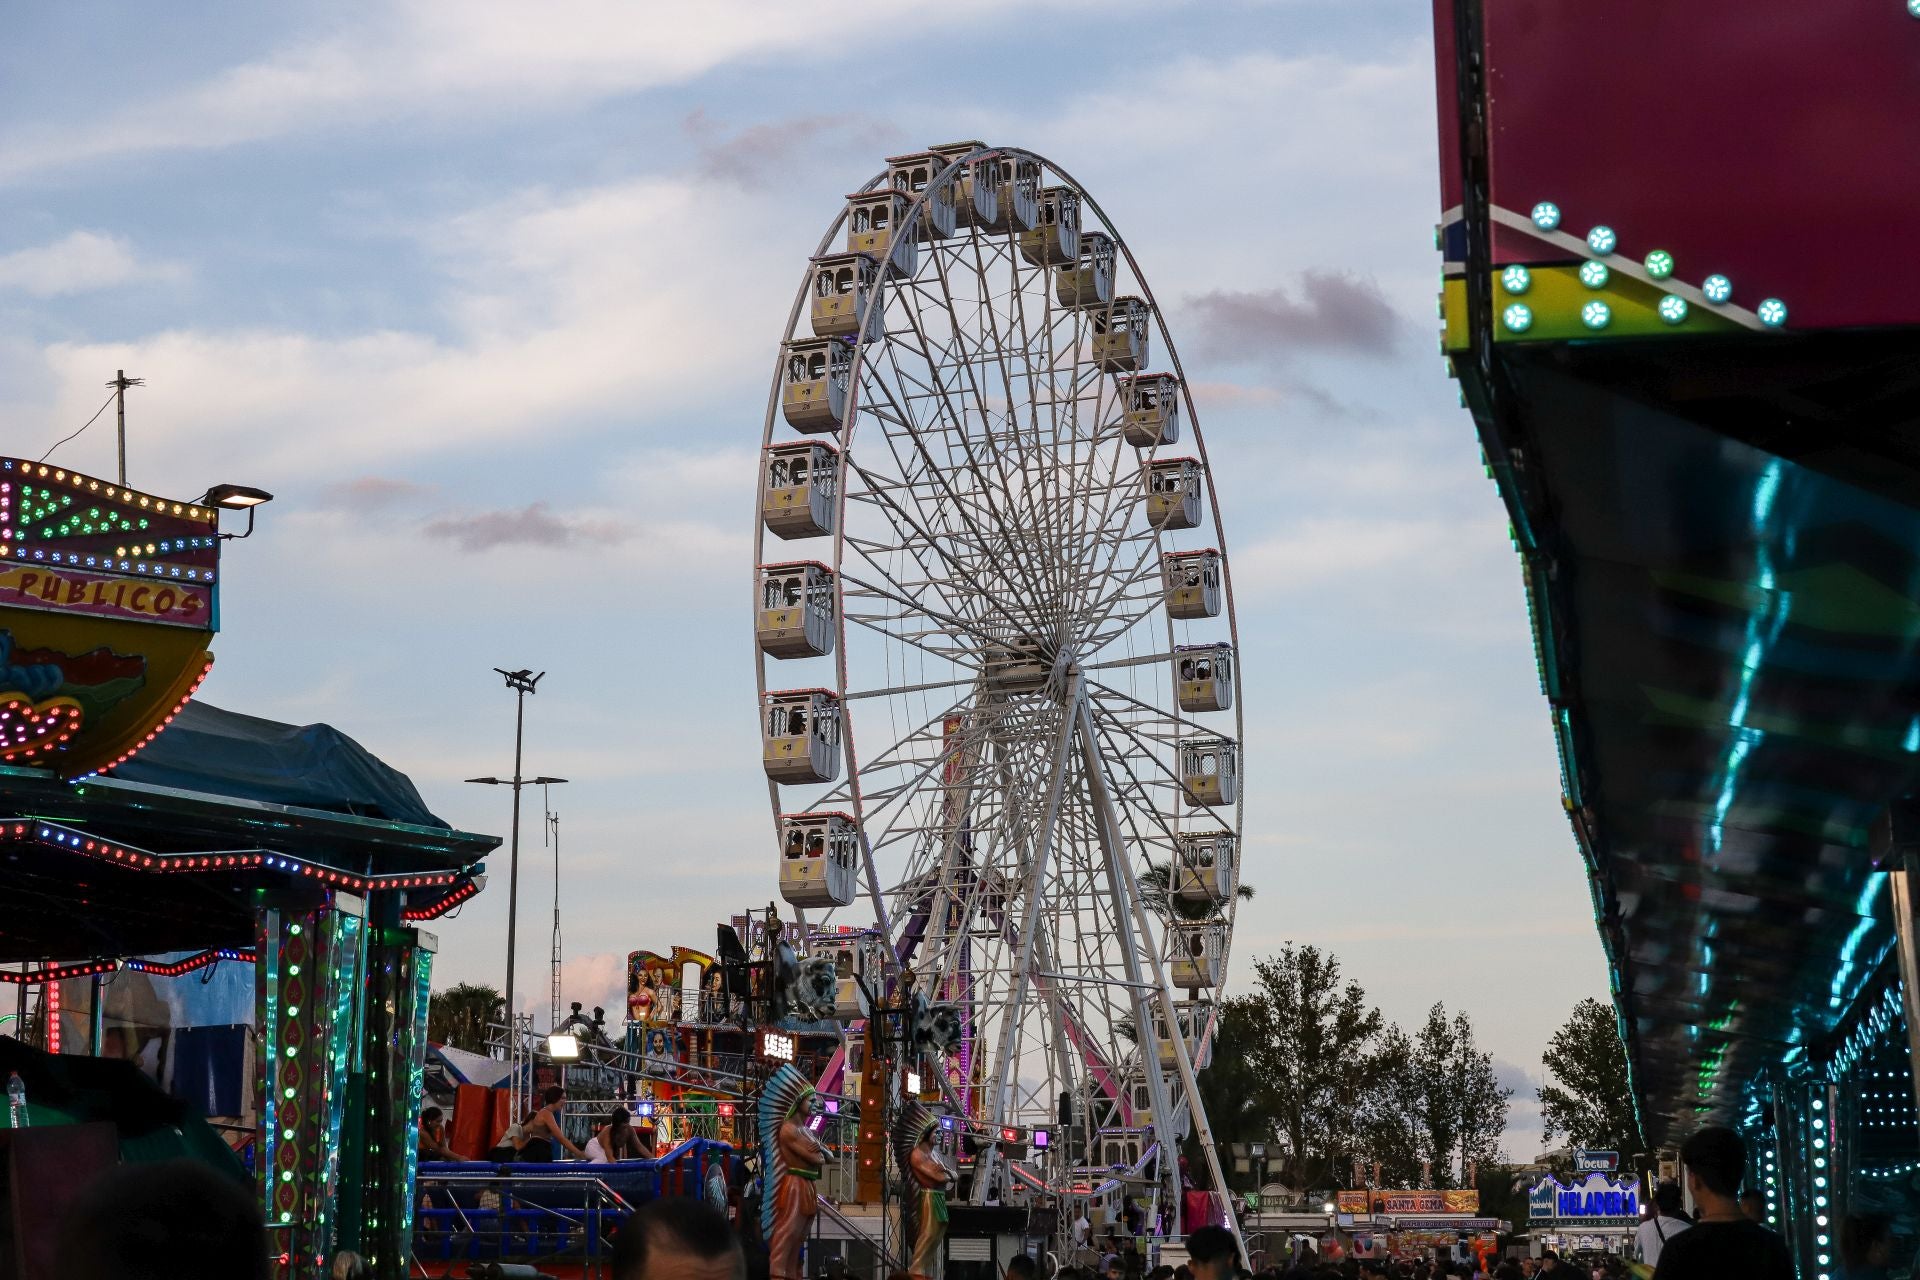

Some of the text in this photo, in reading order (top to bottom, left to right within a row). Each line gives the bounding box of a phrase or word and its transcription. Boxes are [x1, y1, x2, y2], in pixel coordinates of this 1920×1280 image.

[16, 573, 201, 617] PUBLICOS
[1386, 1199, 1444, 1211] SANTA GEMA
[1558, 1191, 1636, 1216] HELADERIA
